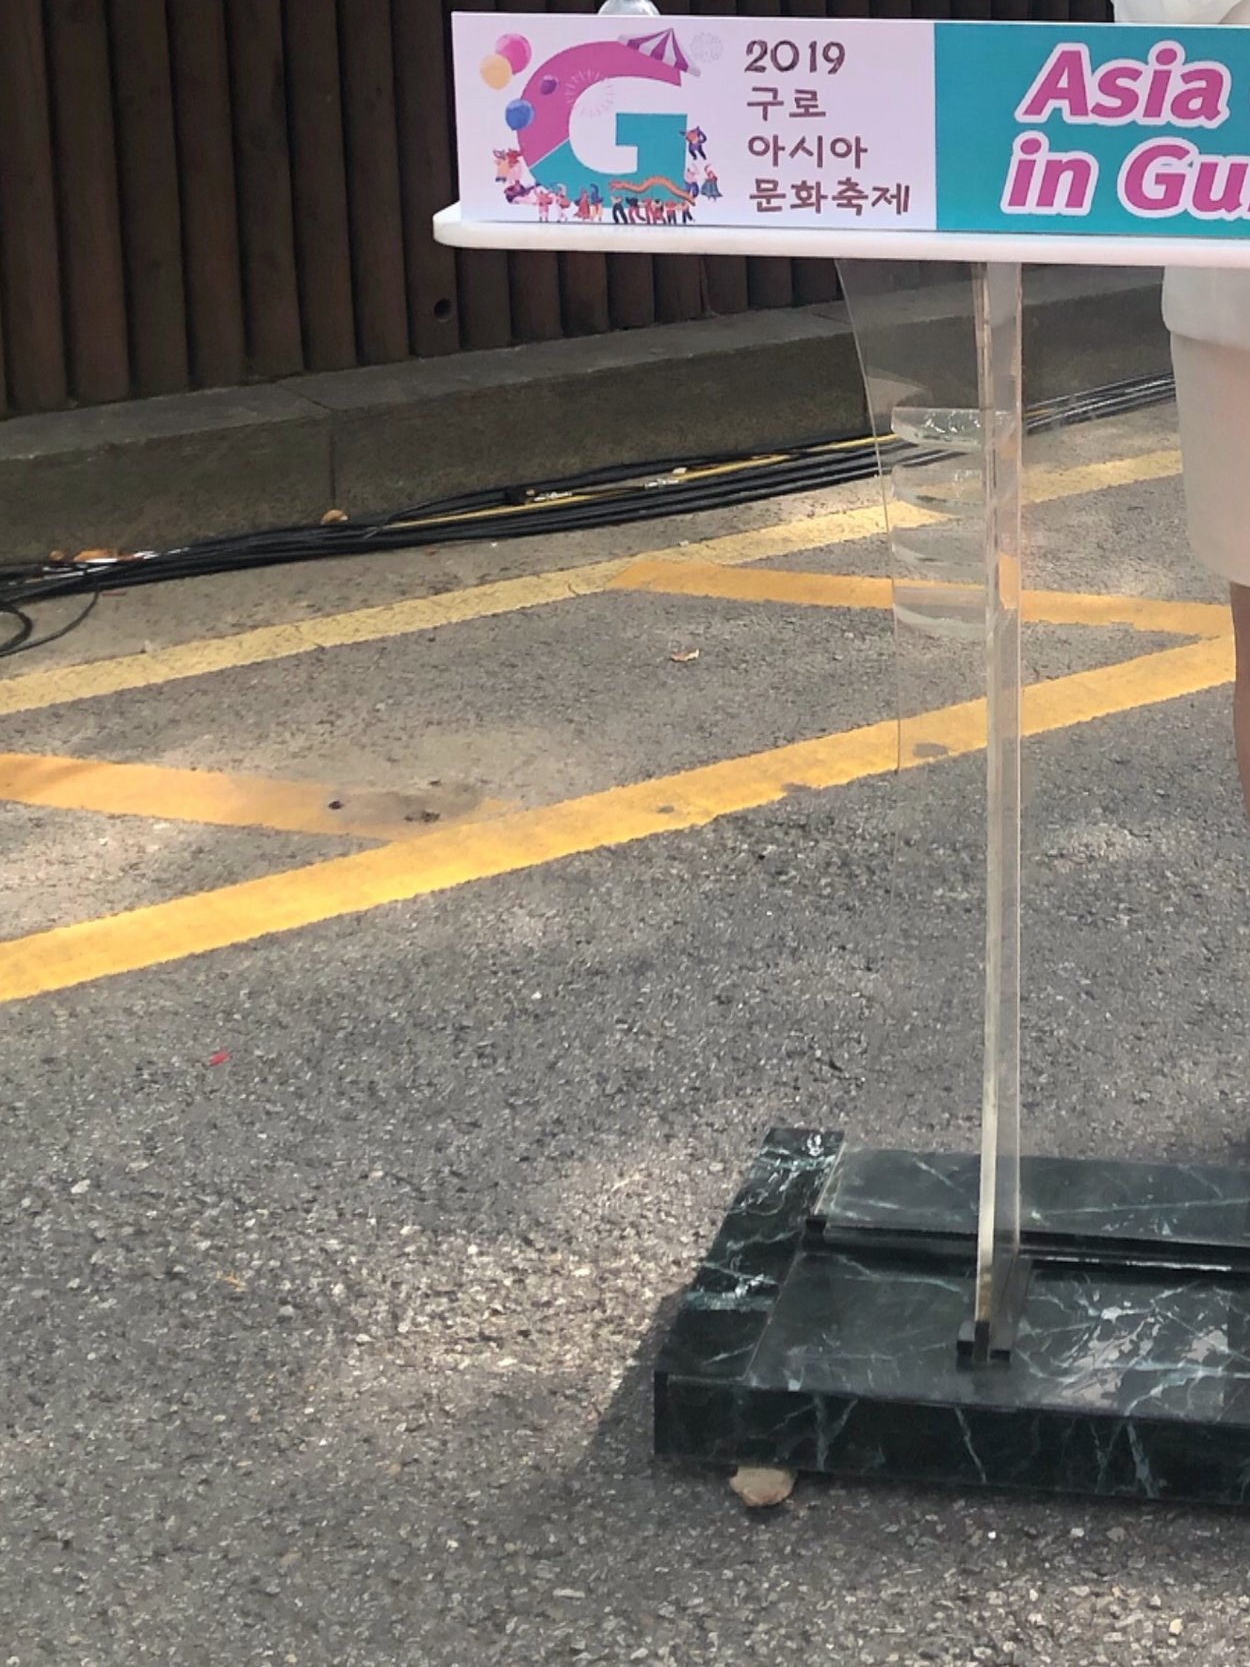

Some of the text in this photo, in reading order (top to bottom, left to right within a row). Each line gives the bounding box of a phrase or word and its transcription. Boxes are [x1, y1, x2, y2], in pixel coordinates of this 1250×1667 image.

[744, 39, 846, 75] 2019
[746, 86, 827, 121] 구로
[1018, 44, 1229, 126] Asia
[747, 134, 868, 169] 아시아
[1003, 134, 1096, 214] in
[748, 177, 911, 216] 문화축제
